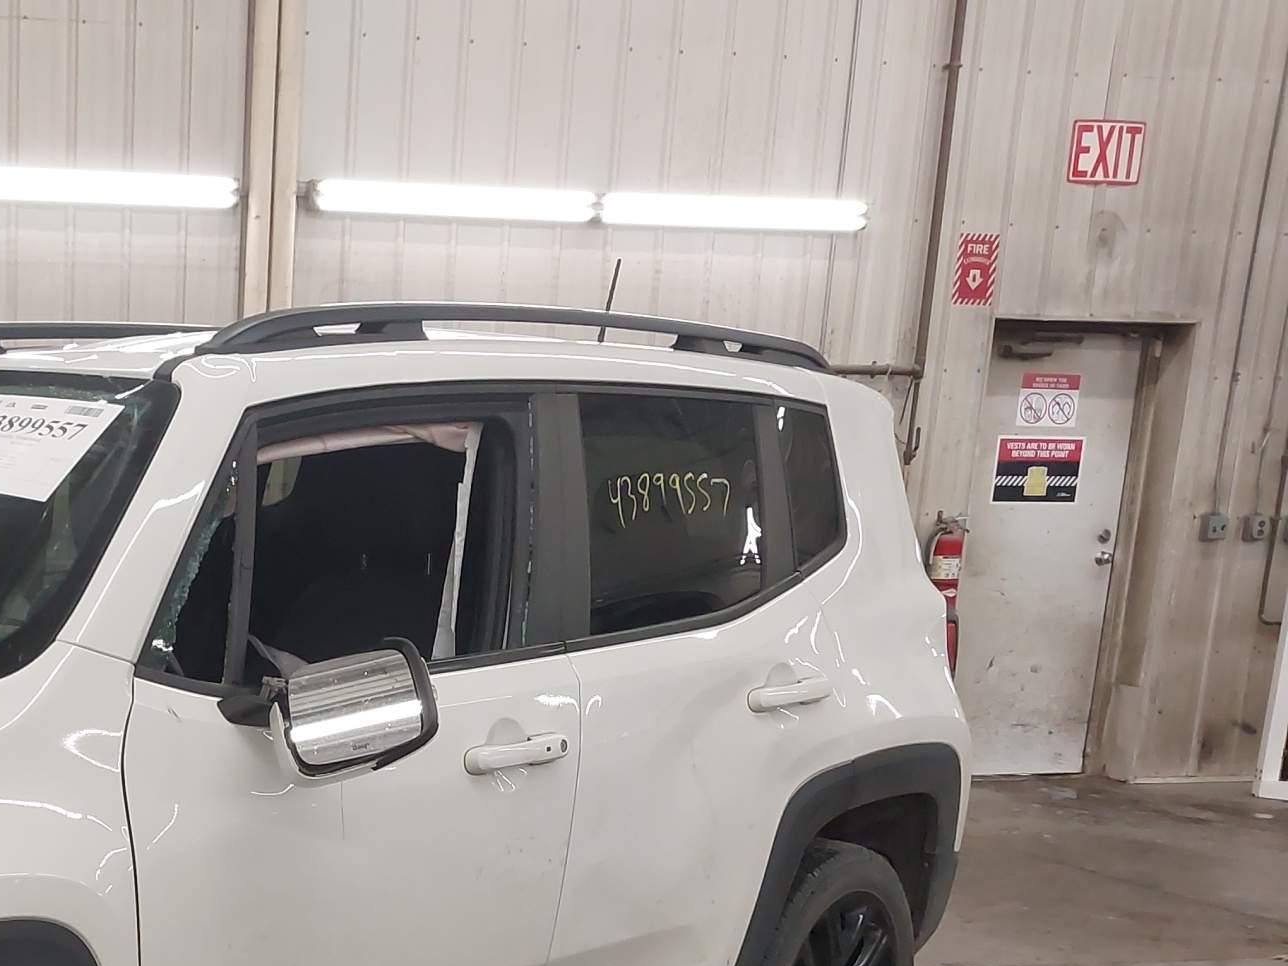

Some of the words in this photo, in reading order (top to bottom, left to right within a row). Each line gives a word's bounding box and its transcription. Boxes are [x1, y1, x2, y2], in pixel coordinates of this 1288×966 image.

[1071, 124, 1143, 180] EXIT
[967, 243, 990, 255] FIRE
[1039, 442, 1047, 450] TO
[608, 472, 730, 529] 43899557
